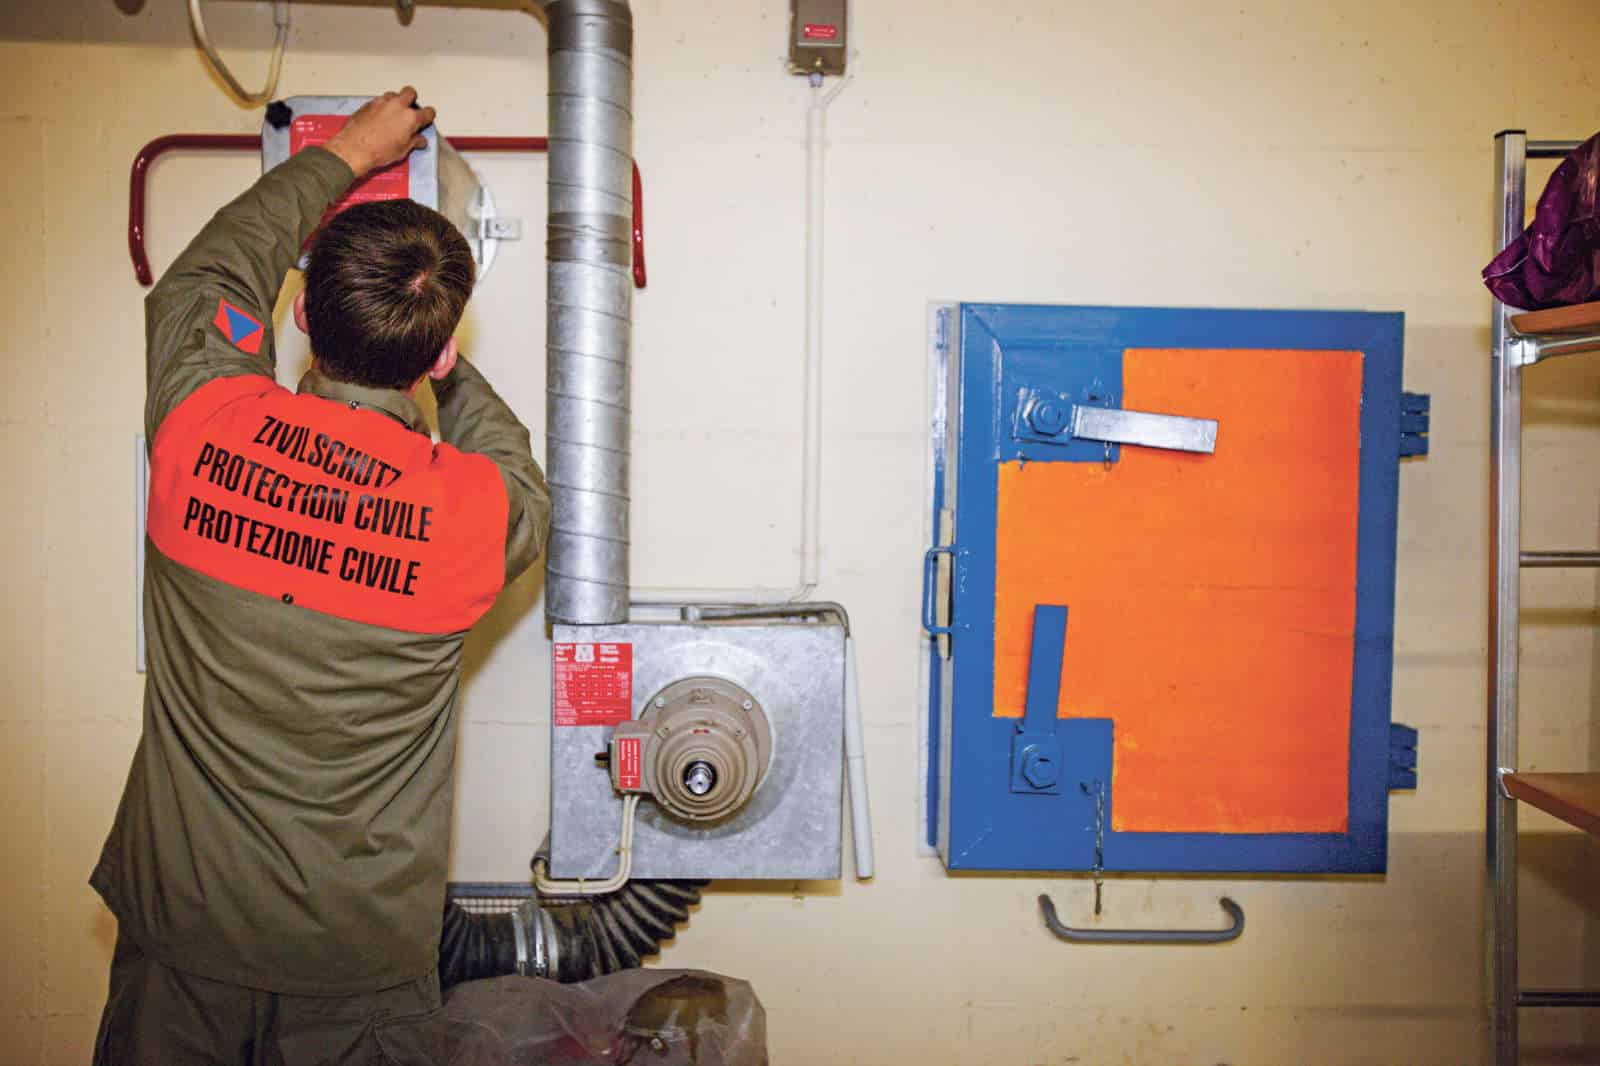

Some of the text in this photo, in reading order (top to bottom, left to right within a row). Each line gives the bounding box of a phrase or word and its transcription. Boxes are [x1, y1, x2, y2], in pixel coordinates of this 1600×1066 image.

[193, 442, 433, 542] PROTECTION CIVILE
[253, 415, 402, 489] ZIVILSCHUTZ
[184, 496, 421, 596] PROTEZIONE CIVILE
